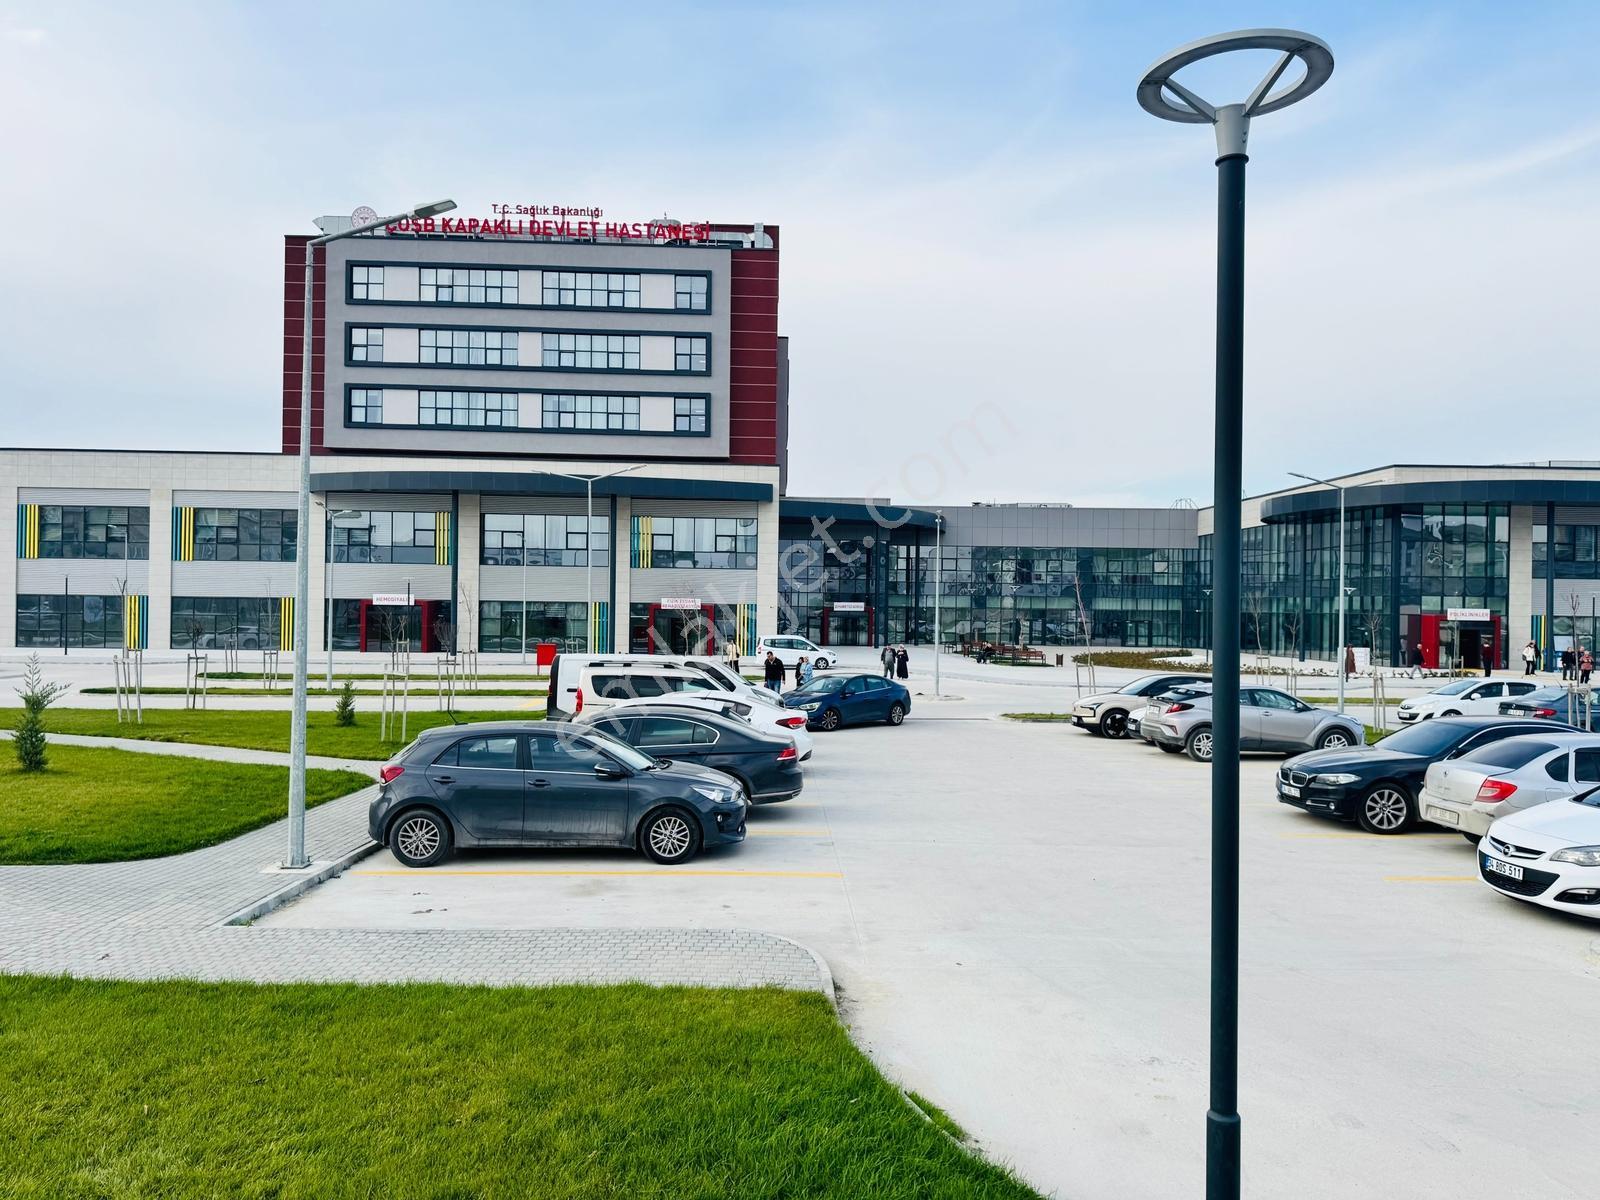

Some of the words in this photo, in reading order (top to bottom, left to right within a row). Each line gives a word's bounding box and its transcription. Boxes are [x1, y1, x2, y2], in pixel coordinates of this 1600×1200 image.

[492, 204, 511, 214] T.C.
[516, 205, 549, 216] Sağlık
[552, 206, 603, 218] Bakanlığı
[441, 217, 523, 235] KAPAKLI
[529, 220, 600, 237] DEVLET
[605, 221, 710, 240] HASTANESİ
[1508, 865, 1521, 878] 511
